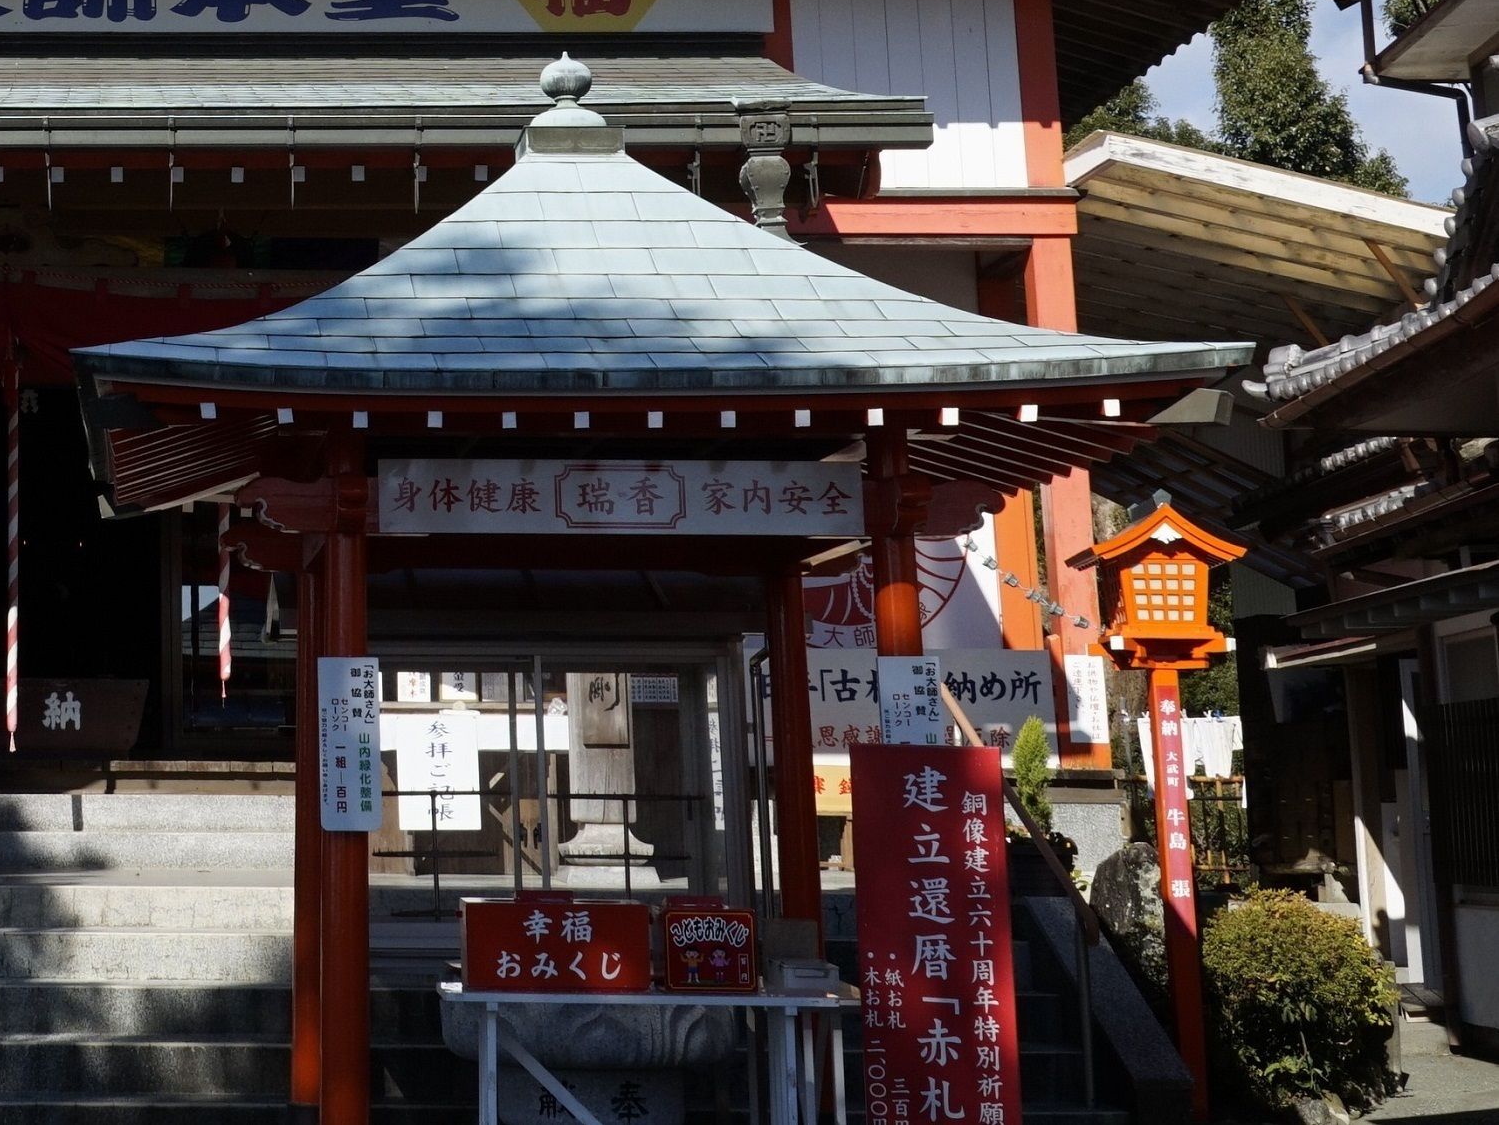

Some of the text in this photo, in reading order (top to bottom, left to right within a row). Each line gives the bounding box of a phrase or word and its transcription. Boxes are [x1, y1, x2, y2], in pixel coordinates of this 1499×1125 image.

[392, 476, 542, 514] 身体健康
[577, 476, 665, 516] 瑞香
[701, 477, 854, 516] 家内安全
[1160, 699, 1179, 737] 奉納
[359, 732, 372, 813] 山内緑化整備
[1166, 808, 1187, 851] 牛島
[522, 909, 593, 944] 幸福
[670, 916, 750, 948] こどもおみくじ
[496, 950, 622, 981] おみくじ
